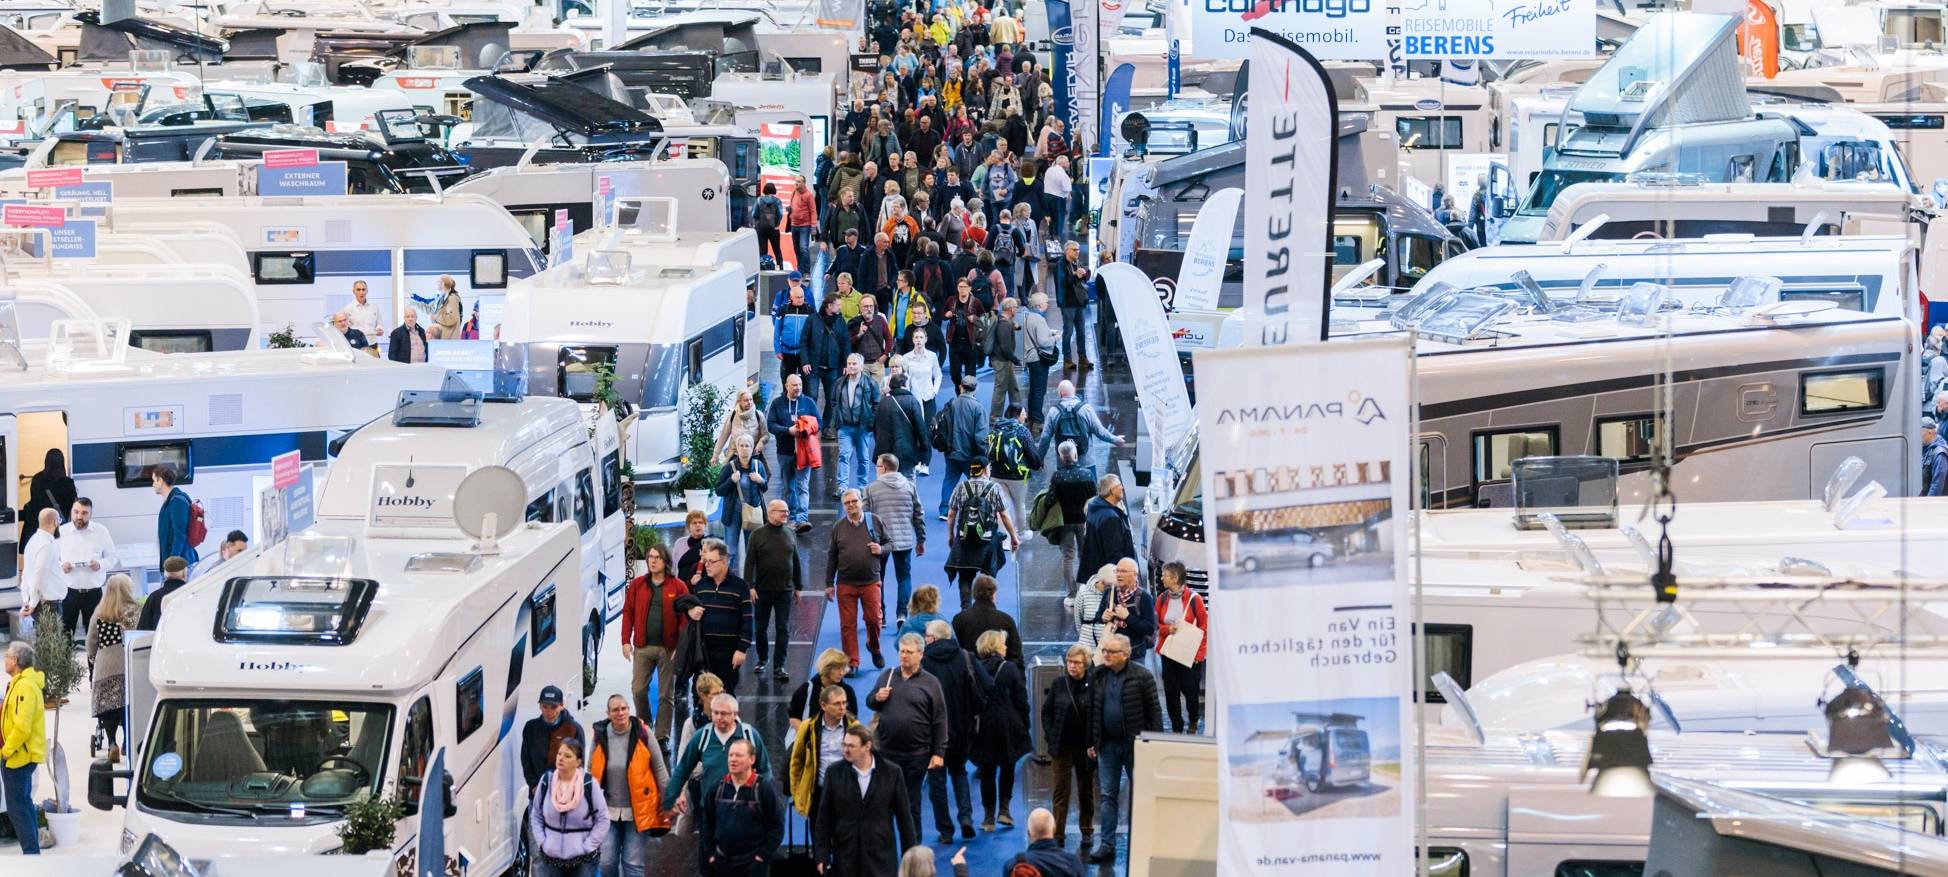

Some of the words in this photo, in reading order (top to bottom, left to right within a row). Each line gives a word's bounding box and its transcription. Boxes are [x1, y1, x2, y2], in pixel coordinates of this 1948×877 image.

[1406, 18, 1494, 32] REISEMOBILE
[1405, 35, 1494, 55] BERENS
[569, 320, 615, 328] Hobby
[377, 495, 436, 510] Hobby
[239, 661, 306, 674] Hobby
